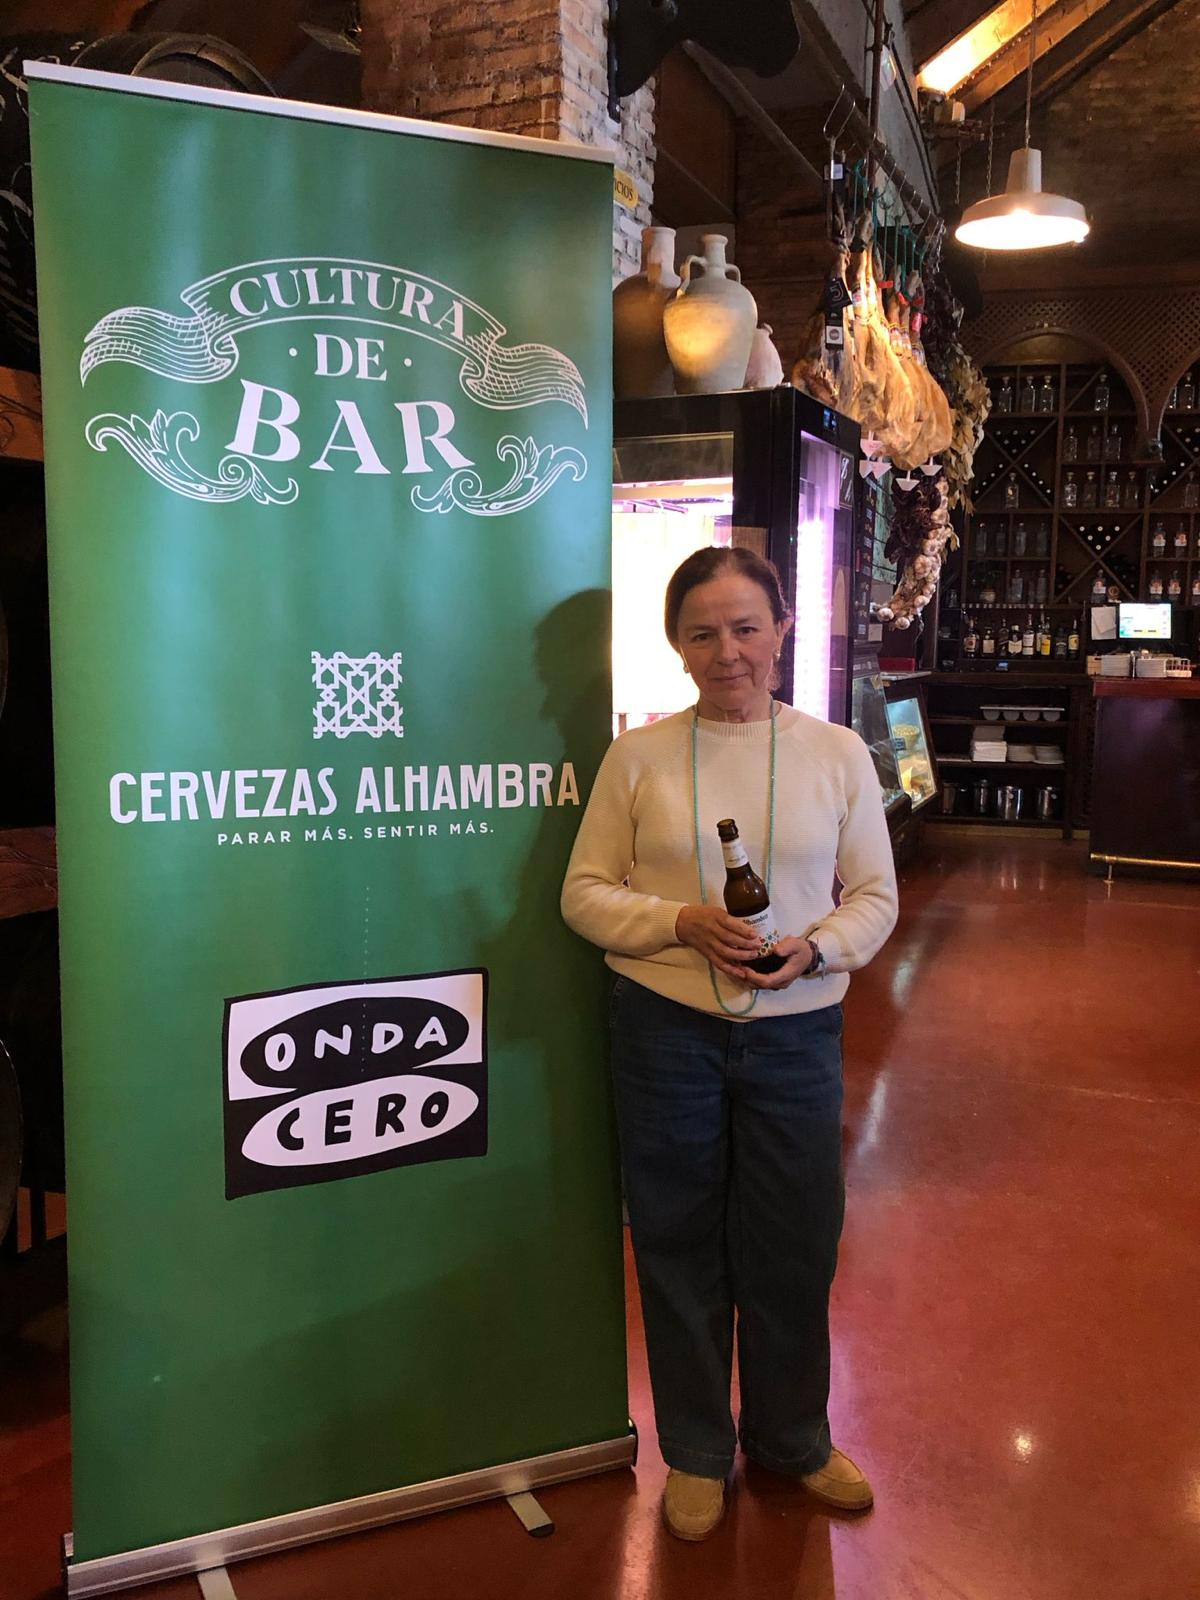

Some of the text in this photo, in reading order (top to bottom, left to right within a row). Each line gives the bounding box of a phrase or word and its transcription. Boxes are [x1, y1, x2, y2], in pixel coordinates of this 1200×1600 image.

[614, 179, 633, 201] ICIOS
[229, 267, 465, 342] CULTURA
[313, 333, 388, 382] DE
[224, 378, 476, 475] BAR
[109, 762, 580, 824] CERVEZAS ALHAMBRA
[217, 819, 494, 846] PARAR MÁS. SENTIR MÁS.
[264, 1016, 448, 1072] ONDA
[276, 1090, 450, 1151] CERO
